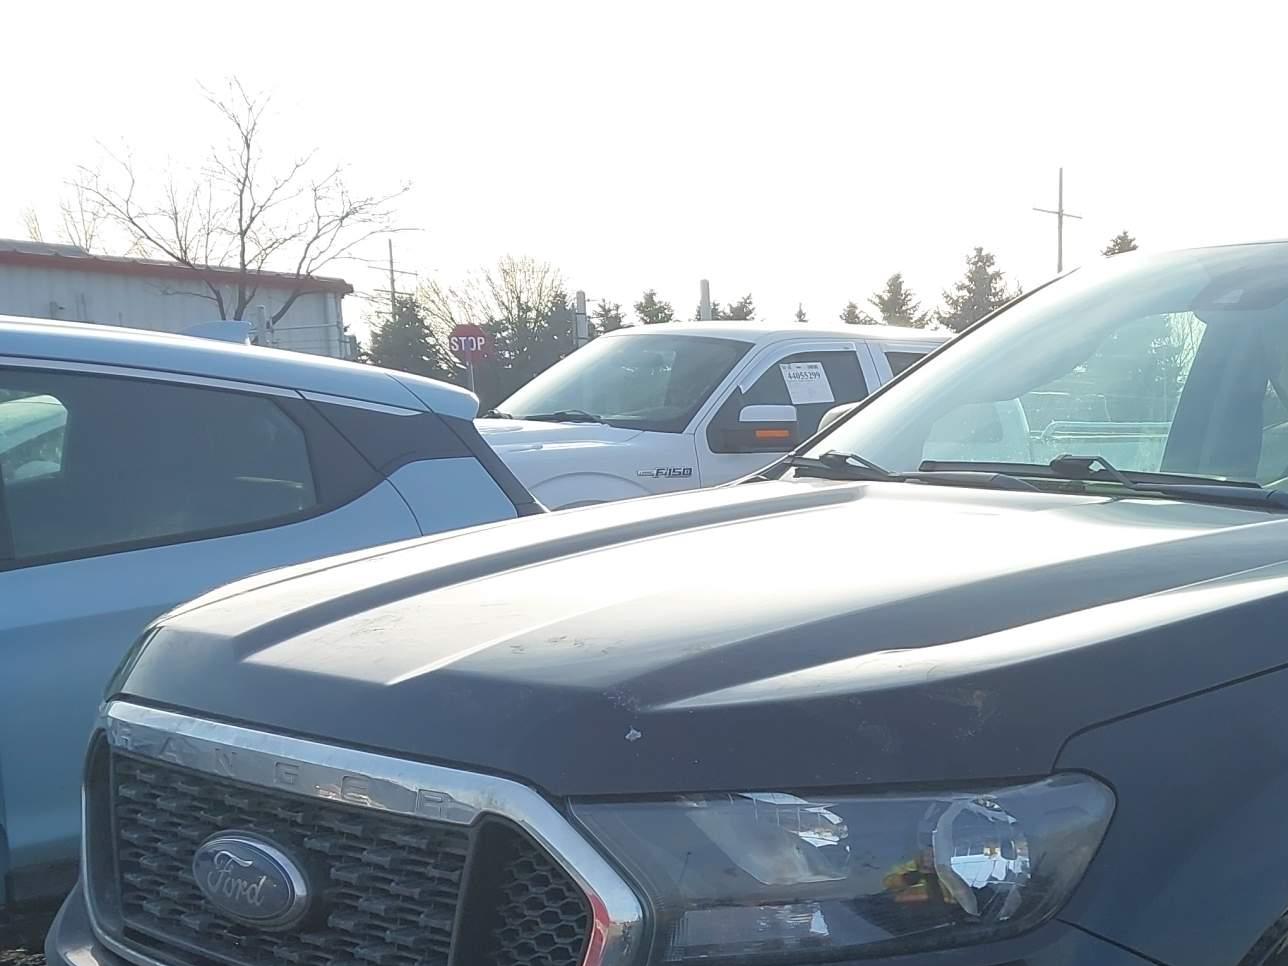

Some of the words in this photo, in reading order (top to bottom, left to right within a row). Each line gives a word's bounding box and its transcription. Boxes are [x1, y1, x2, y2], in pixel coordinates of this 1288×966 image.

[450, 336, 485, 352] STOP
[111, 716, 451, 818] RANGER
[207, 850, 268, 906] Ford
